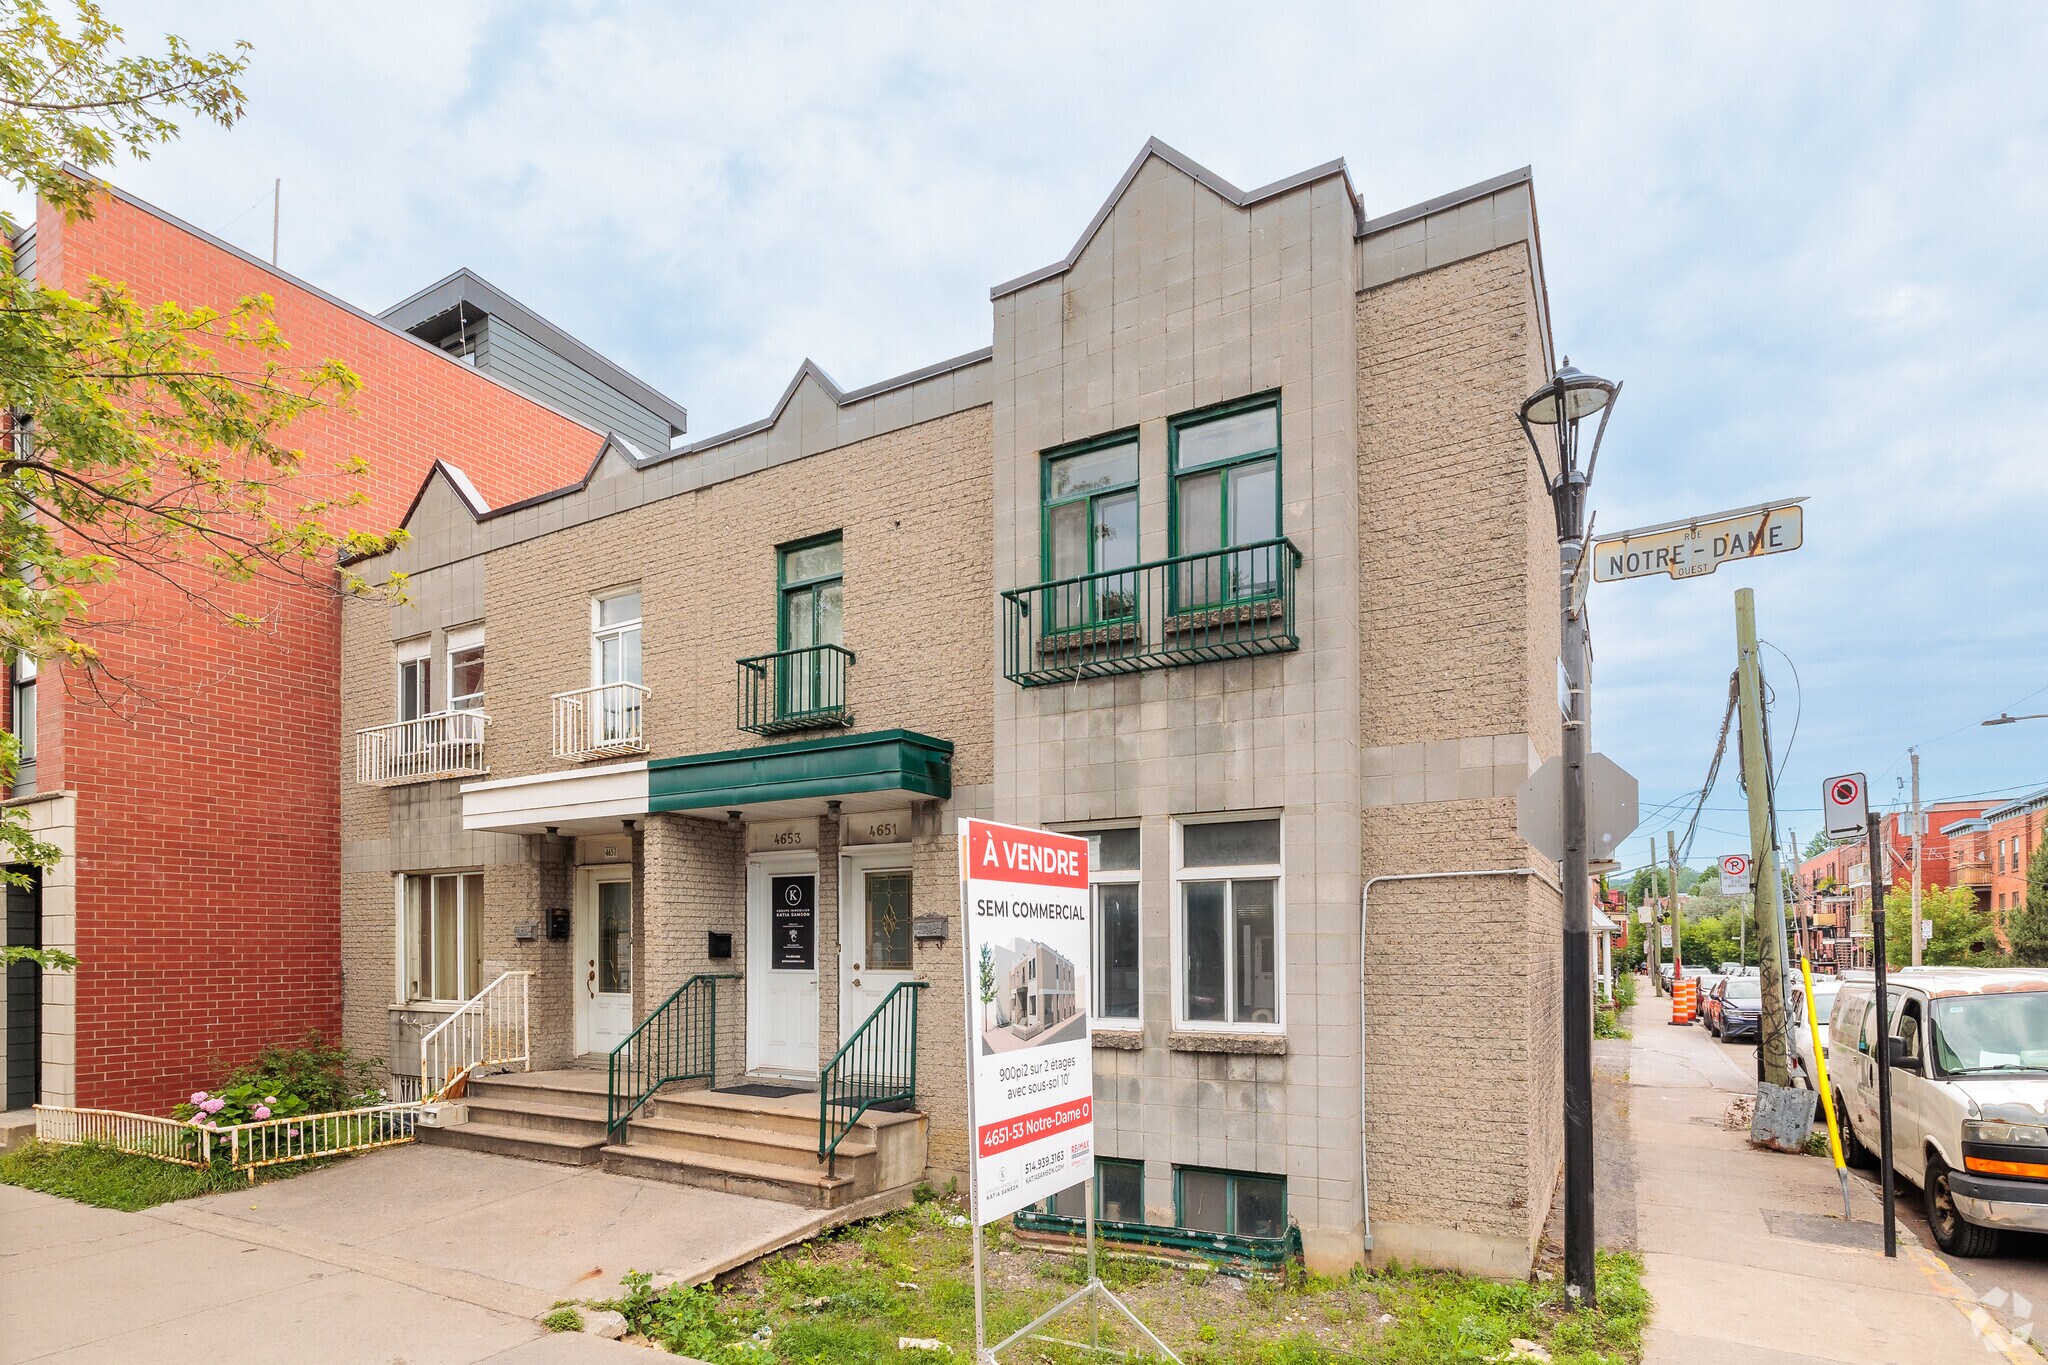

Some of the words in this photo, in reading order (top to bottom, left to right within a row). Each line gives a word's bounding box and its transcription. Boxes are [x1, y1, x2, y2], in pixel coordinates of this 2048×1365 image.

[1684, 530, 1703, 541] RUE
[1678, 563, 1708, 576] OUEST
[773, 832, 801, 844] 4653
[869, 823, 898, 837] 4651
[982, 830, 1000, 867] À
[1003, 840, 1080, 876] VENDRE
[789, 889, 797, 901] K
[977, 899, 1009, 918] SEMI
[1012, 901, 1085, 920] COMMERCIAL
[999, 1063, 1029, 1082] 900pi2
[1030, 1062, 1043, 1075] sur
[1044, 1059, 1049, 1072] 2
[1050, 1056, 1076, 1071] étages
[1007, 1085, 1027, 1100] avec
[1028, 1074, 1060, 1094] sous-sol
[984, 1121, 1024, 1147] 4651-53
[1026, 1109, 1081, 1135] Notre-Dame
[1082, 1103, 1090, 1117] O
[1025, 1150, 1065, 1174] 514.939.3163
[986, 1191, 1000, 1200] KATIA
[1001, 1184, 1019, 1196] SAMSON
